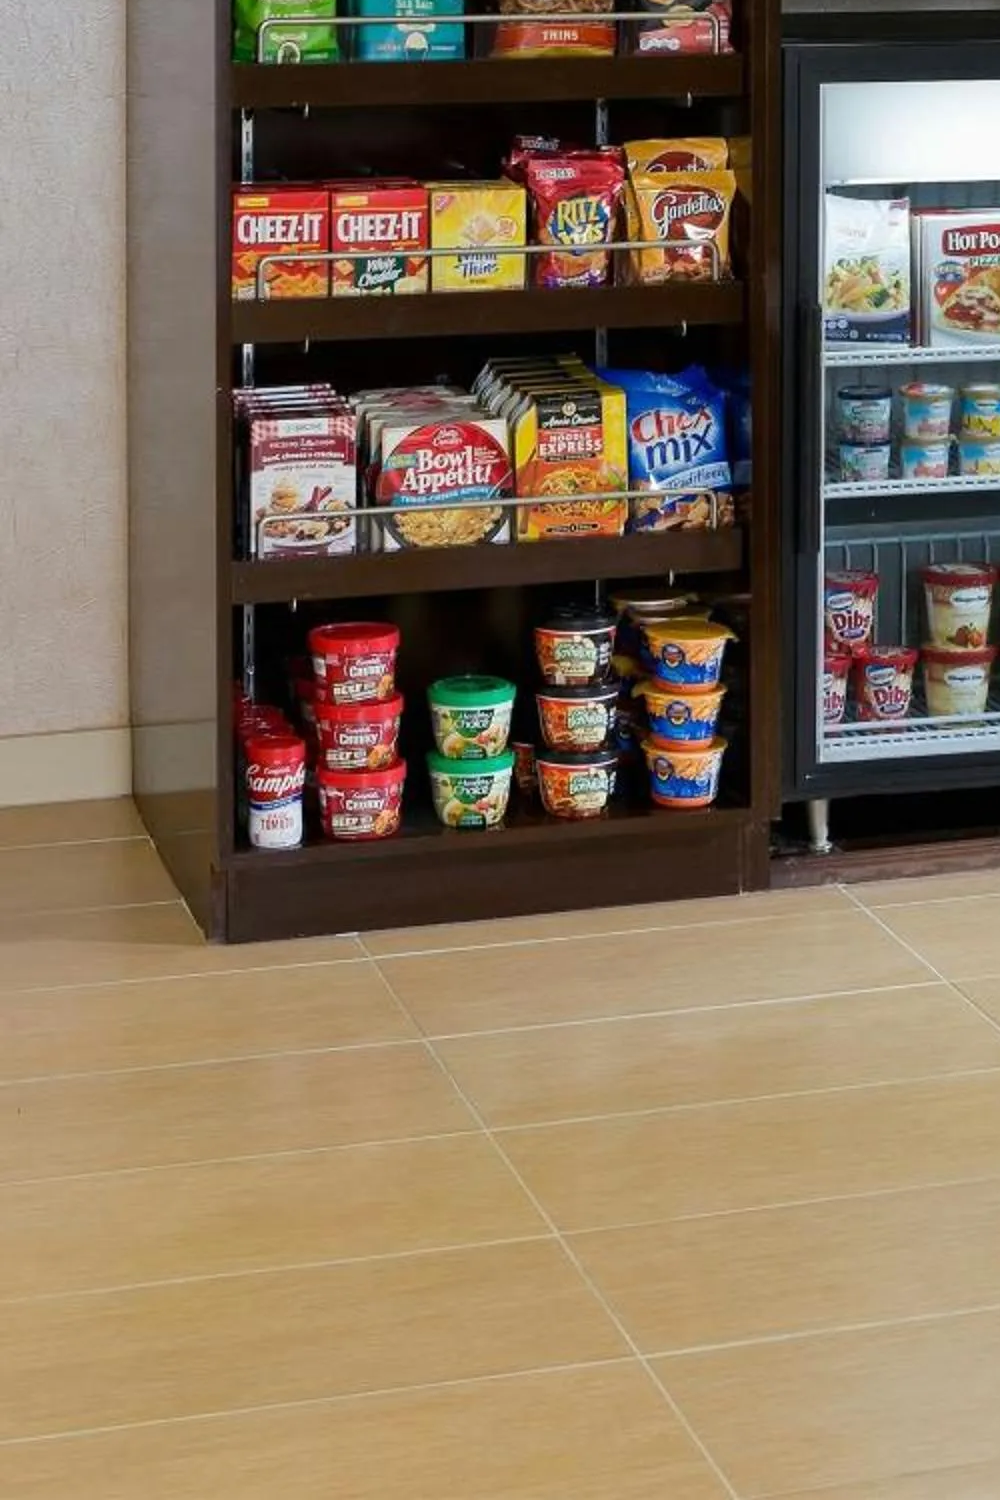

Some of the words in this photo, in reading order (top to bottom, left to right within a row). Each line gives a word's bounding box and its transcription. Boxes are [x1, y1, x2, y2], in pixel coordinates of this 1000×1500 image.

[237, 212, 324, 244] CHEEZ-IT
[336, 211, 422, 244] CHEEZ-IT
[948, 231, 976, 252] HOT
[631, 405, 712, 443] Chex
[415, 445, 473, 473] Bowl
[538, 438, 603, 457] EXPRESS
[645, 422, 713, 470] mix
